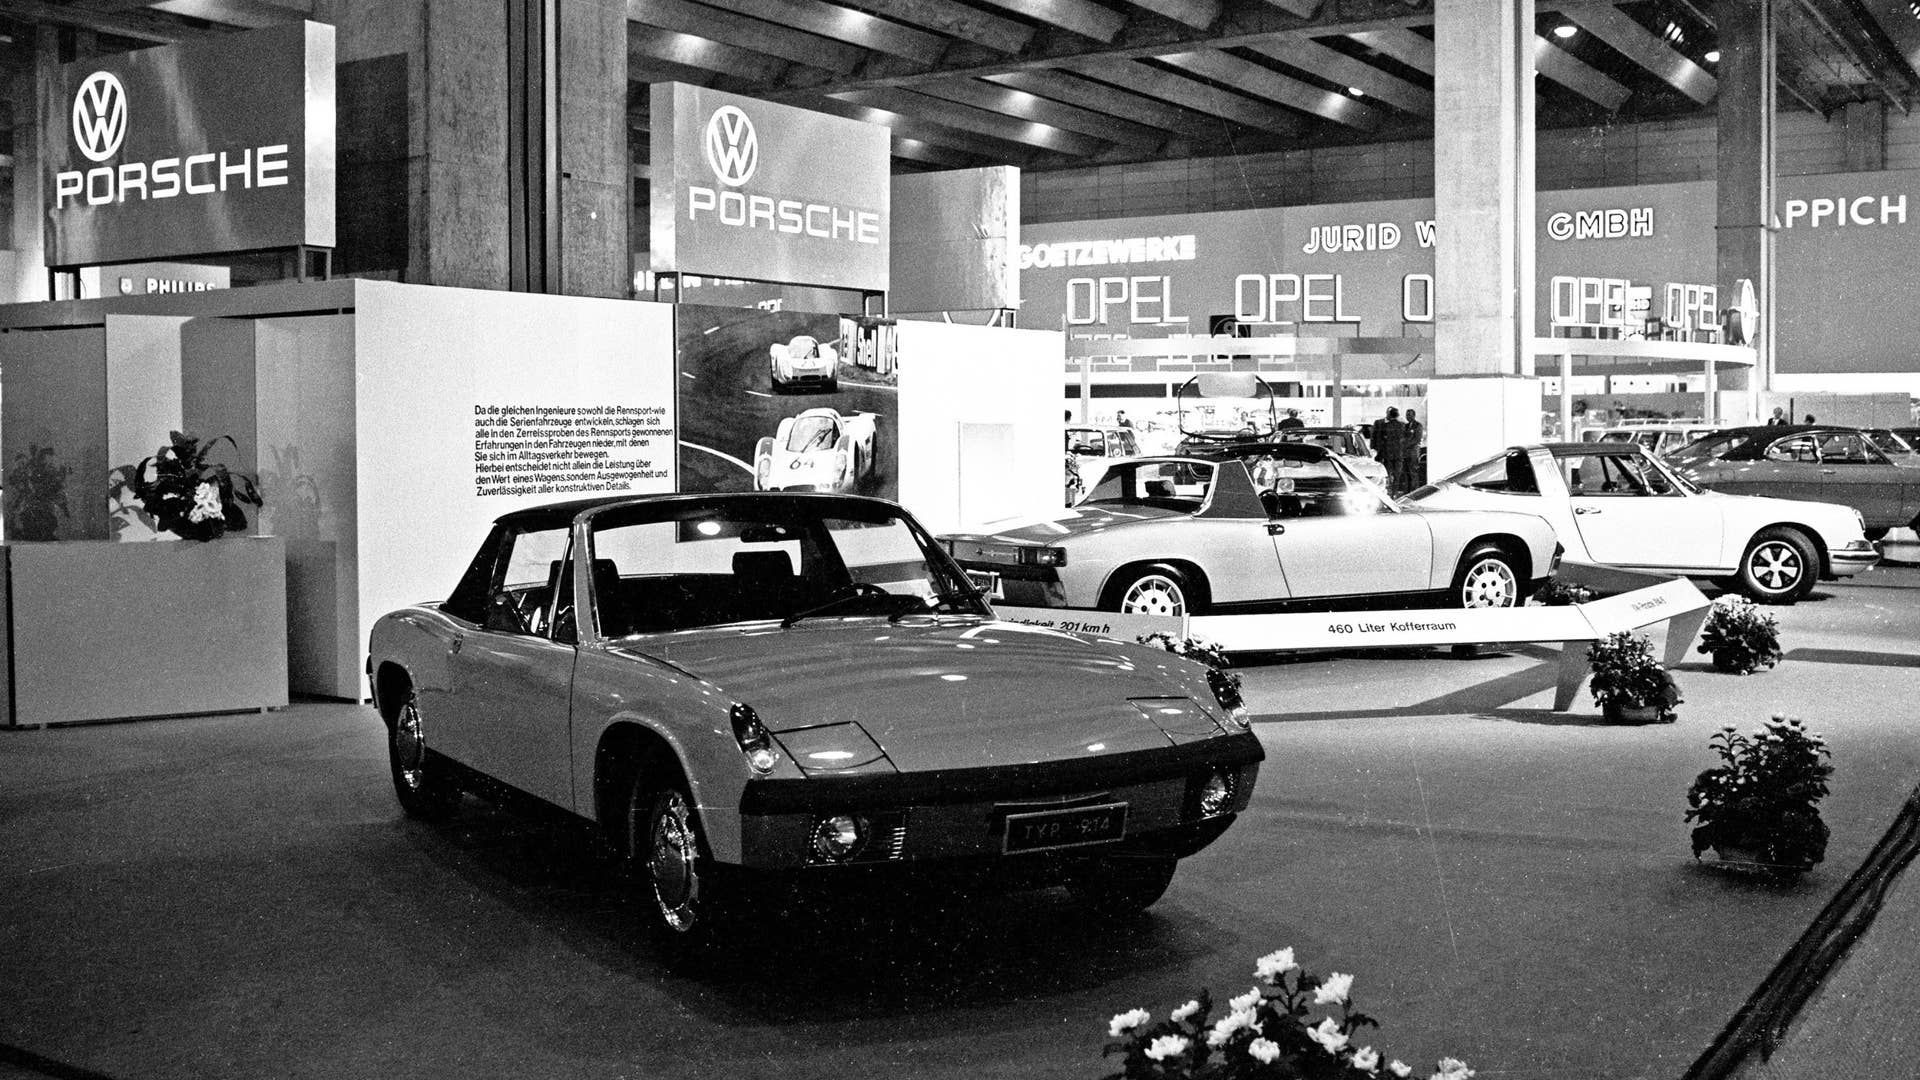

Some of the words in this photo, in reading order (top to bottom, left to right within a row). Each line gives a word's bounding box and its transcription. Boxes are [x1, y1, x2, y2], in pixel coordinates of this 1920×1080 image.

[56, 144, 288, 208] PORSCHE
[689, 186, 879, 244] PORSCHE
[1775, 195, 1906, 228] PPICH
[1304, 222, 1400, 254] JURID
[1546, 208, 1654, 241] GMBH
[1017, 235, 1196, 269] GOETZEWERKE
[1066, 276, 1189, 325] OPEL
[1235, 273, 1361, 322] OPEL
[475, 405, 486, 415] Da
[487, 405, 499, 415] die
[502, 406, 534, 416] gleichen
[536, 406, 575, 416] Ingenieure
[577, 406, 603, 415] sowohl
[605, 406, 615, 414] die
[475, 417, 494, 426] auch
[496, 417, 508, 426] die
[510, 417, 572, 428] Serienfahrzeuge
[615, 417, 644, 427] schlagen
[647, 417, 660, 425] sich
[475, 429, 489, 438] alle
[491, 429, 498, 438] in
[499, 429, 514, 438] den
[517, 429, 574, 439] Zerreissproben
[591, 428, 631, 437] Rennsports
[632, 429, 673, 438] gewonnenen
[475, 440, 524, 451] Erfahrungen
[525, 440, 532, 449] in
[534, 440, 548, 448] den
[549, 439, 590, 450] Fahrzeugen
[475, 452, 487, 461] Sie
[489, 452, 505, 460] sich
[507, 452, 517, 460] im
[519, 451, 572, 462] Alltagsverkehr
[574, 451, 609, 460] bewegen.
[476, 463, 504, 472] Hierbei
[506, 462, 551, 471] entscheidet
[553, 462, 570, 470] nicht
[572, 460, 591, 470] allein
[593, 460, 603, 468] die
[605, 460, 634, 470] Leistung
[636, 460, 651, 468] über
[476, 476, 491, 484] den
[491, 475, 510, 483] Wert
[513, 475, 533, 483] eines
[597, 470, 653, 481] Ausgewogenheit
[477, 485, 536, 496] Zuverlässigkeit
[538, 485, 554, 493] aller
[556, 484, 604, 493] konstruktiven
[1060, 622, 1080, 631] 201
[1082, 623, 1100, 633] km
[1328, 624, 1353, 634] 460
[1359, 622, 1385, 633] Liter
[1390, 620, 1456, 632] Kofferraum
[1024, 823, 1060, 840] TYP
